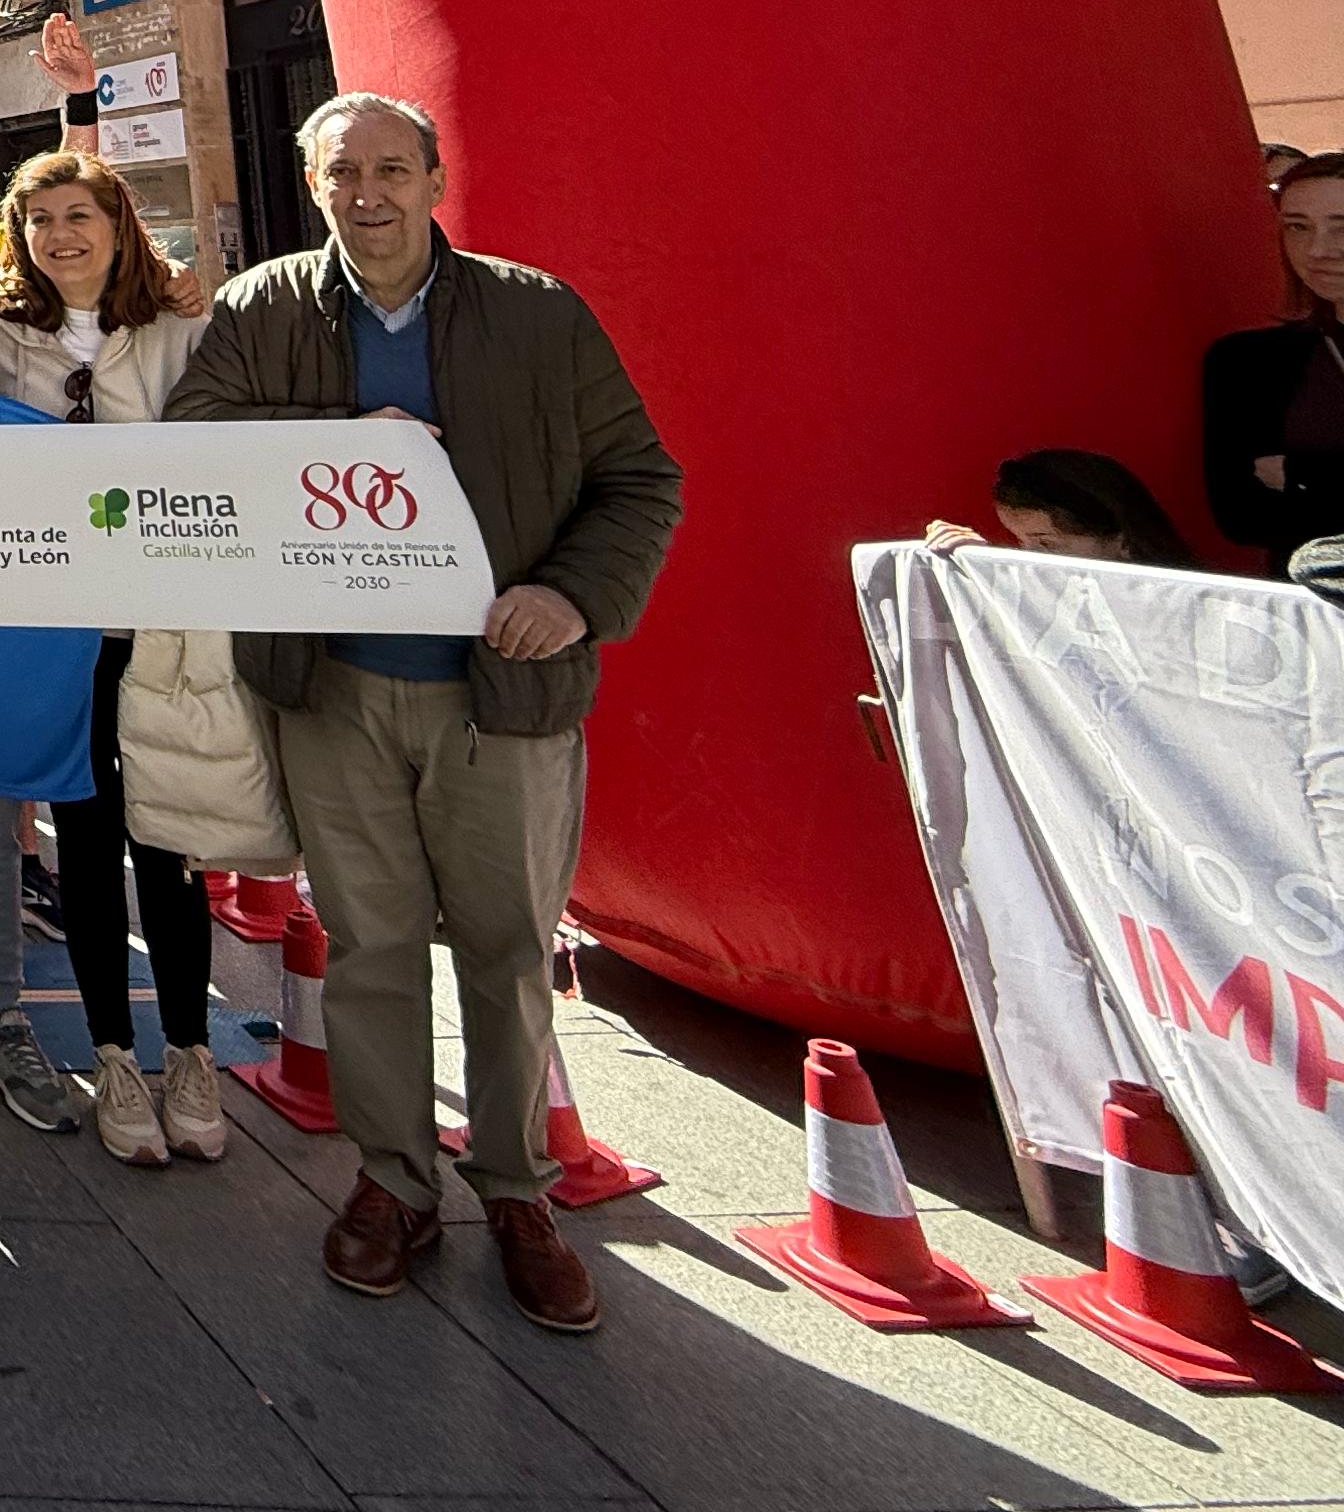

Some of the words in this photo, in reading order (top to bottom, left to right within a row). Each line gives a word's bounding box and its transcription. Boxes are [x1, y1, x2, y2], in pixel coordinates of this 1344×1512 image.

[137, 486, 238, 518] Plena
[41, 527, 68, 544] de
[139, 518, 239, 538] inclusión
[142, 542, 205, 559] Castilla
[204, 545, 214, 561] y
[216, 543, 256, 559] León
[280, 540, 337, 550] Aniversario
[338, 541, 369, 551] Unión
[371, 541, 385, 550] de
[386, 541, 403, 551] los
[405, 542, 440, 552] Reinos
[442, 543, 456, 552] de
[19, 547, 70, 565] León
[281, 549, 336, 566] LEÓN
[342, 553, 354, 566] Y
[361, 553, 459, 568] CASTILLA
[344, 576, 390, 590] 2030
